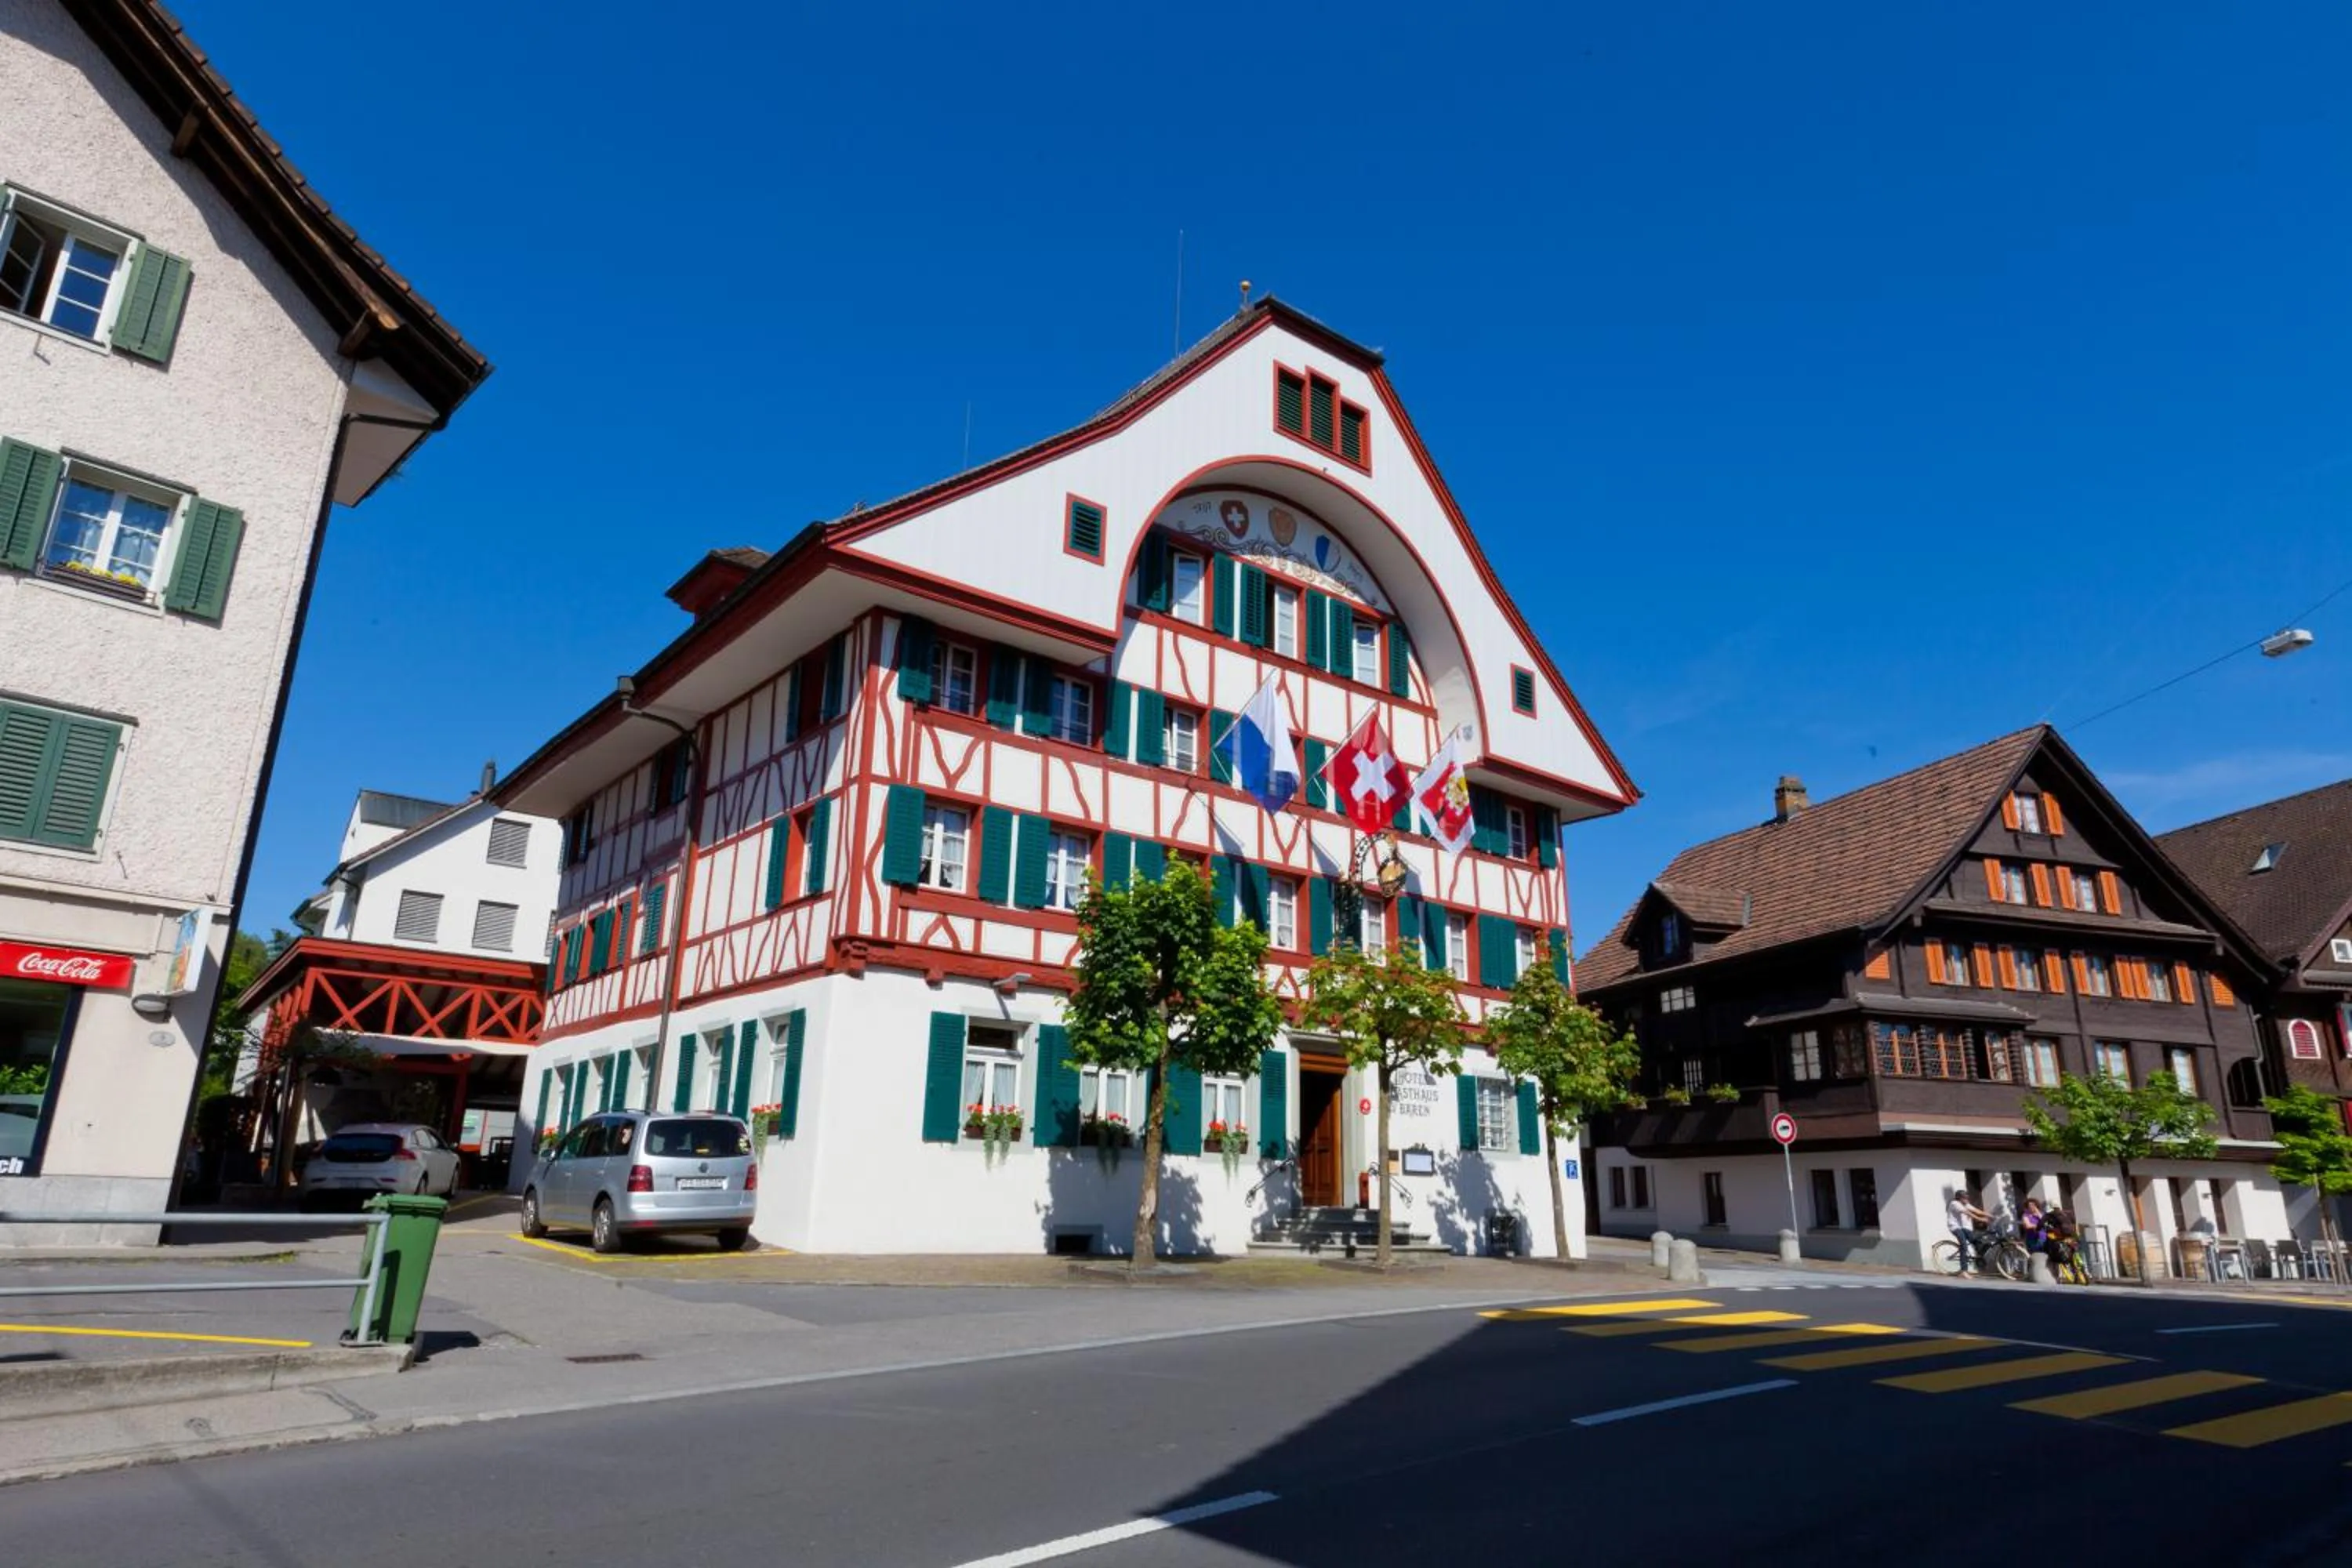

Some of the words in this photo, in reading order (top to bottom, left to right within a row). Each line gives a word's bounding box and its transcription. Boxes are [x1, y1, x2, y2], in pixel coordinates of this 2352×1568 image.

[17, 952, 107, 979] Coca-Cola
[1399, 1071, 1434, 1085] HOTE
[1391, 1087, 1439, 1102] ASTHAUS
